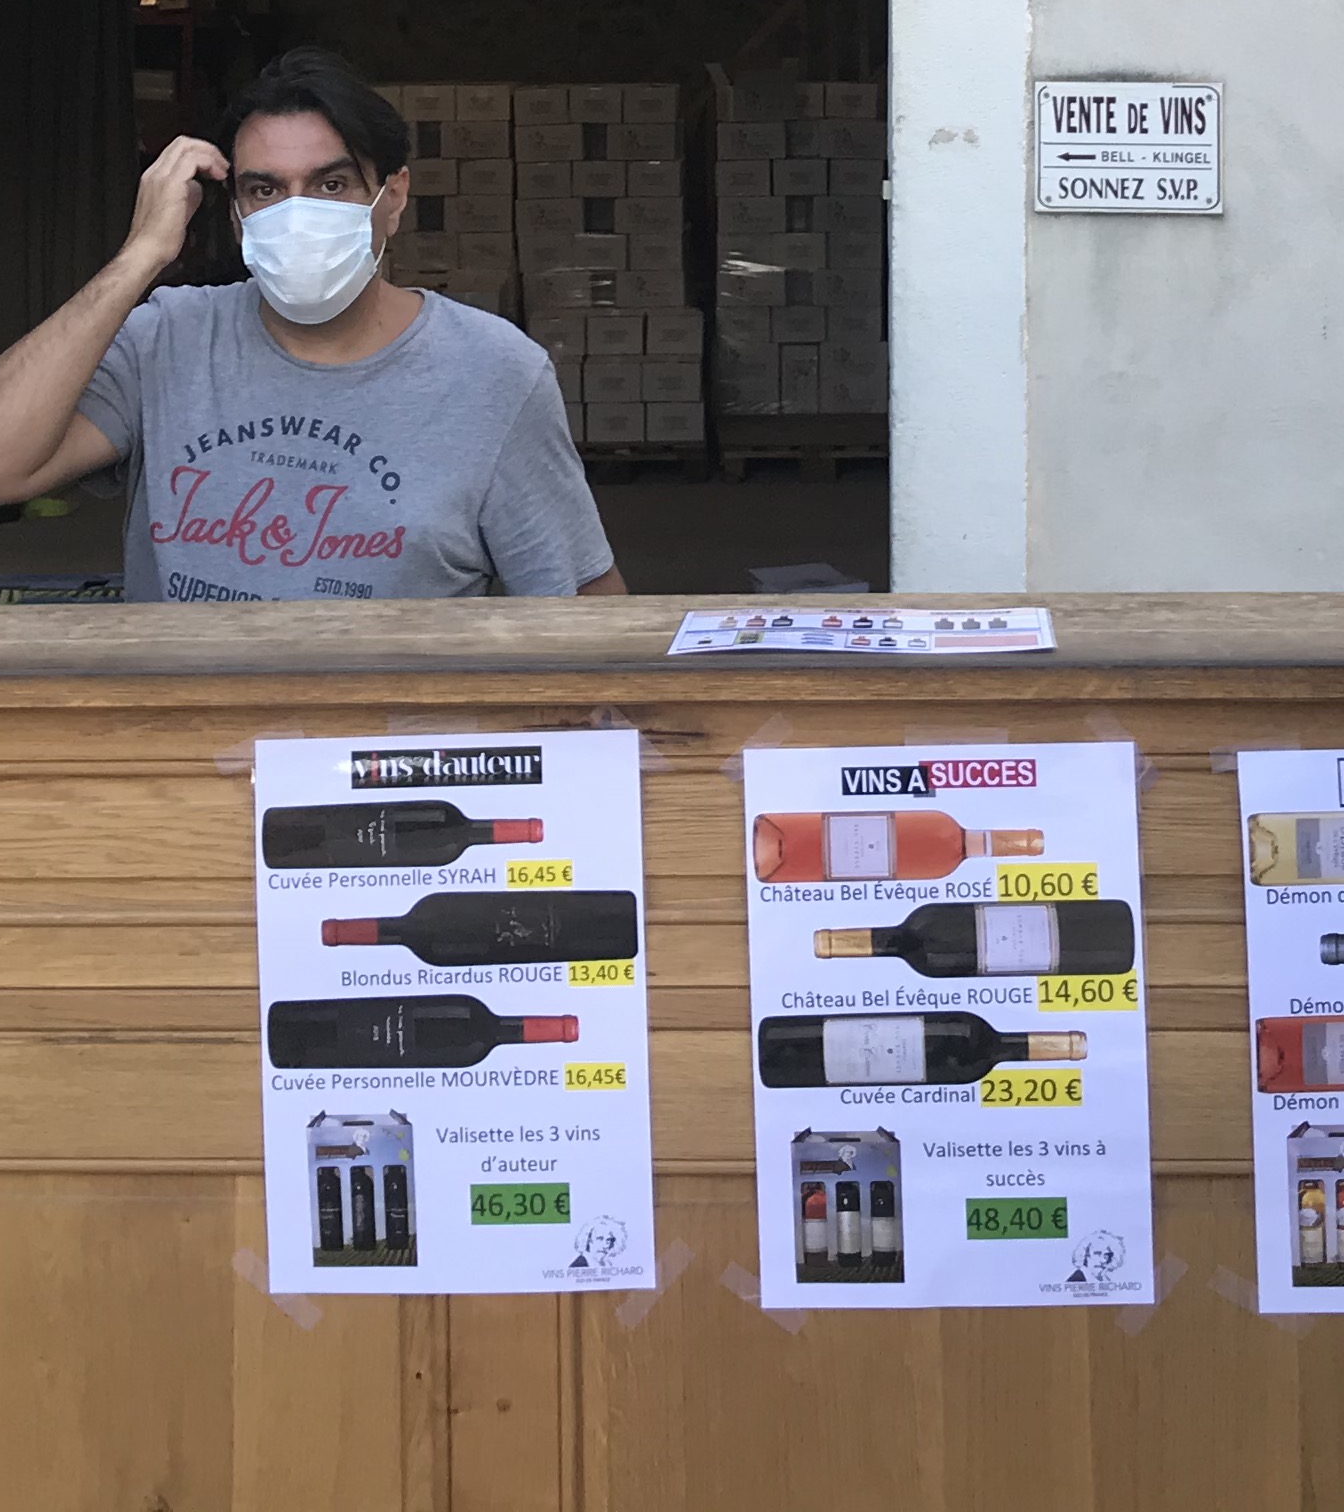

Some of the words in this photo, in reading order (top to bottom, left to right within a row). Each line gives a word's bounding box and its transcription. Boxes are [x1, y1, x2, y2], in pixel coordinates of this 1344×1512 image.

[1052, 96, 1117, 134] VENTE
[1128, 103, 1148, 134] DE
[1160, 97, 1206, 135] VINS
[1101, 151, 1135, 162] BELL
[1152, 151, 1211, 164] KLINGEL
[1058, 176, 1144, 200] SONNEZ
[1156, 178, 1198, 200] S.V.P.
[184, 415, 364, 463] JEANSWEAR
[369, 455, 401, 505] CO.
[250, 450, 338, 475] TRADEMARK
[149, 464, 274, 566] Jack
[261, 515, 295, 551] &
[280, 484, 405, 568] Jones
[354, 751, 413, 779] vins
[423, 750, 539, 776] d'auteur
[844, 769, 903, 793] VINS
[931, 760, 1034, 787] SUCCES
[268, 873, 321, 890] Cuvée
[328, 870, 432, 889] Personnelle
[437, 868, 496, 885] SYRAH
[507, 865, 556, 885] 16,45
[561, 865, 573, 882] €
[760, 884, 834, 903] Château
[840, 883, 867, 901] Bel
[874, 881, 939, 904] Évêque
[945, 877, 992, 898] ROSÉ
[999, 873, 1074, 902] 10,60
[1083, 873, 1098, 896] €
[1266, 887, 1332, 905] Démon
[341, 969, 412, 987] Blondus
[418, 967, 493, 986] Ricardus
[498, 966, 562, 983] ROUGE
[569, 964, 619, 984] 13,40
[623, 964, 634, 980] €
[781, 991, 856, 1009] Château
[862, 989, 890, 1006] Bel
[896, 985, 961, 1010] Évêque
[967, 987, 1032, 1004] ROUGE
[1039, 979, 1114, 1008] 14,60
[1123, 979, 1138, 1001] €
[271, 1073, 326, 1091] Cuvée
[332, 1072, 436, 1090] Personnelle
[441, 1066, 559, 1088] MOURVÈDRE
[565, 1067, 626, 1088] 16,45€
[840, 1087, 895, 1105] Cuvée
[901, 1086, 976, 1104] Cardinal
[981, 1080, 1057, 1106] 23,20
[1066, 1079, 1082, 1101] €
[1273, 1093, 1339, 1111] Démon
[436, 1126, 514, 1144] Valisette
[519, 1126, 543, 1143] les
[548, 1125, 559, 1142] 3
[564, 1125, 601, 1142] vins
[923, 1141, 1002, 1158] Valisette
[1008, 1141, 1033, 1157] les
[1039, 1141, 1049, 1156] 3
[1054, 1141, 1090, 1156] vins
[1095, 1141, 1106, 1156] à
[481, 1155, 557, 1173] d'auteur
[986, 1170, 1046, 1187] succès
[471, 1192, 546, 1222] 46,30
[556, 1191, 571, 1216] €
[967, 1208, 1043, 1236] 48,40
[1052, 1207, 1068, 1230] €
[542, 1269, 565, 1279] VINS
[567, 1268, 598, 1278] PIERRE
[600, 1266, 644, 1276] RICHARD
[1039, 1283, 1062, 1292] VINS
[1098, 1282, 1142, 1291] RICHARD
